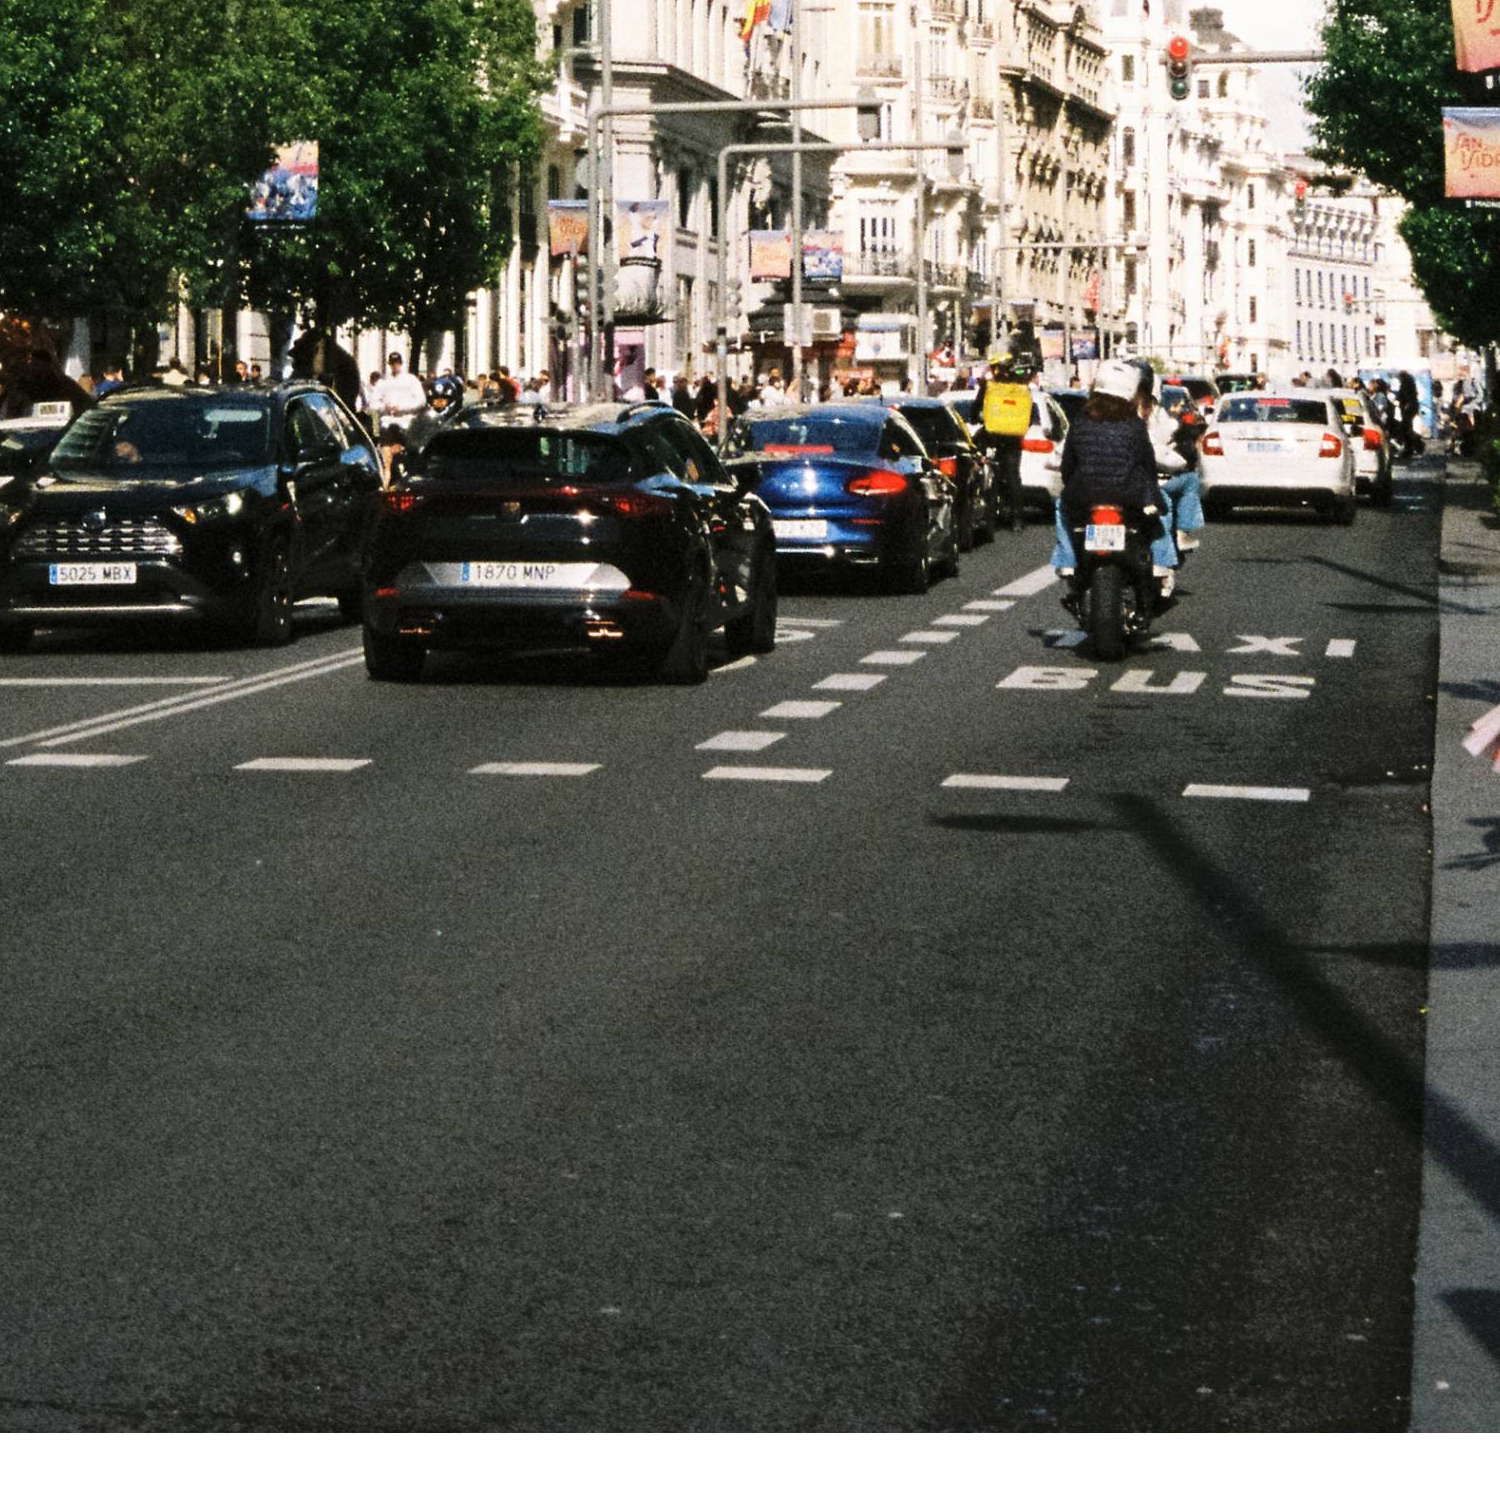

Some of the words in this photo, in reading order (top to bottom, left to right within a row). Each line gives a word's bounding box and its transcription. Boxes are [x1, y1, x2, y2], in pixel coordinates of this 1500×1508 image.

[60, 566, 97, 581] 5025
[103, 566, 132, 581] MBX
[476, 565, 518, 580] 1870
[523, 565, 555, 580] MNP
[995, 665, 1316, 699] BUS
